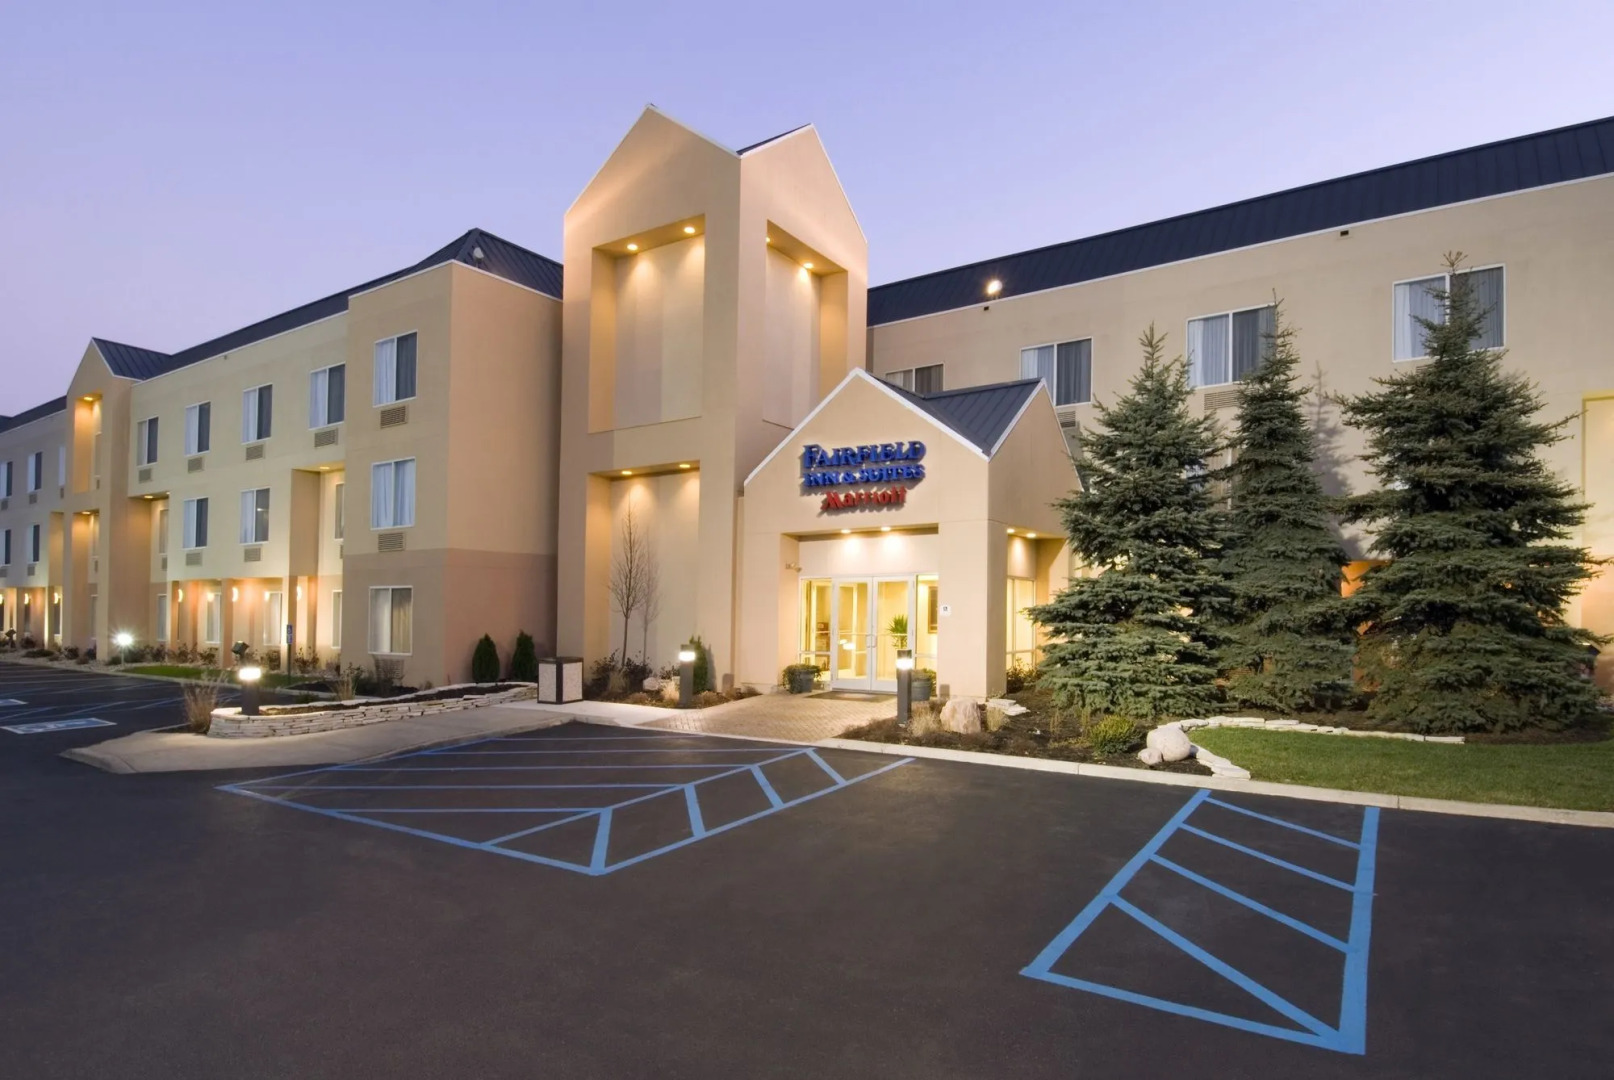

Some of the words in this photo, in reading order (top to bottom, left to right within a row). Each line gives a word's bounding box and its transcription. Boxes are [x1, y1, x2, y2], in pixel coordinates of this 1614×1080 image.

[803, 441, 926, 468] FAIRFIELD
[804, 470, 840, 486] INN
[841, 471, 857, 484] &
[858, 464, 926, 483] SUITES
[820, 485, 907, 511] Marriott
